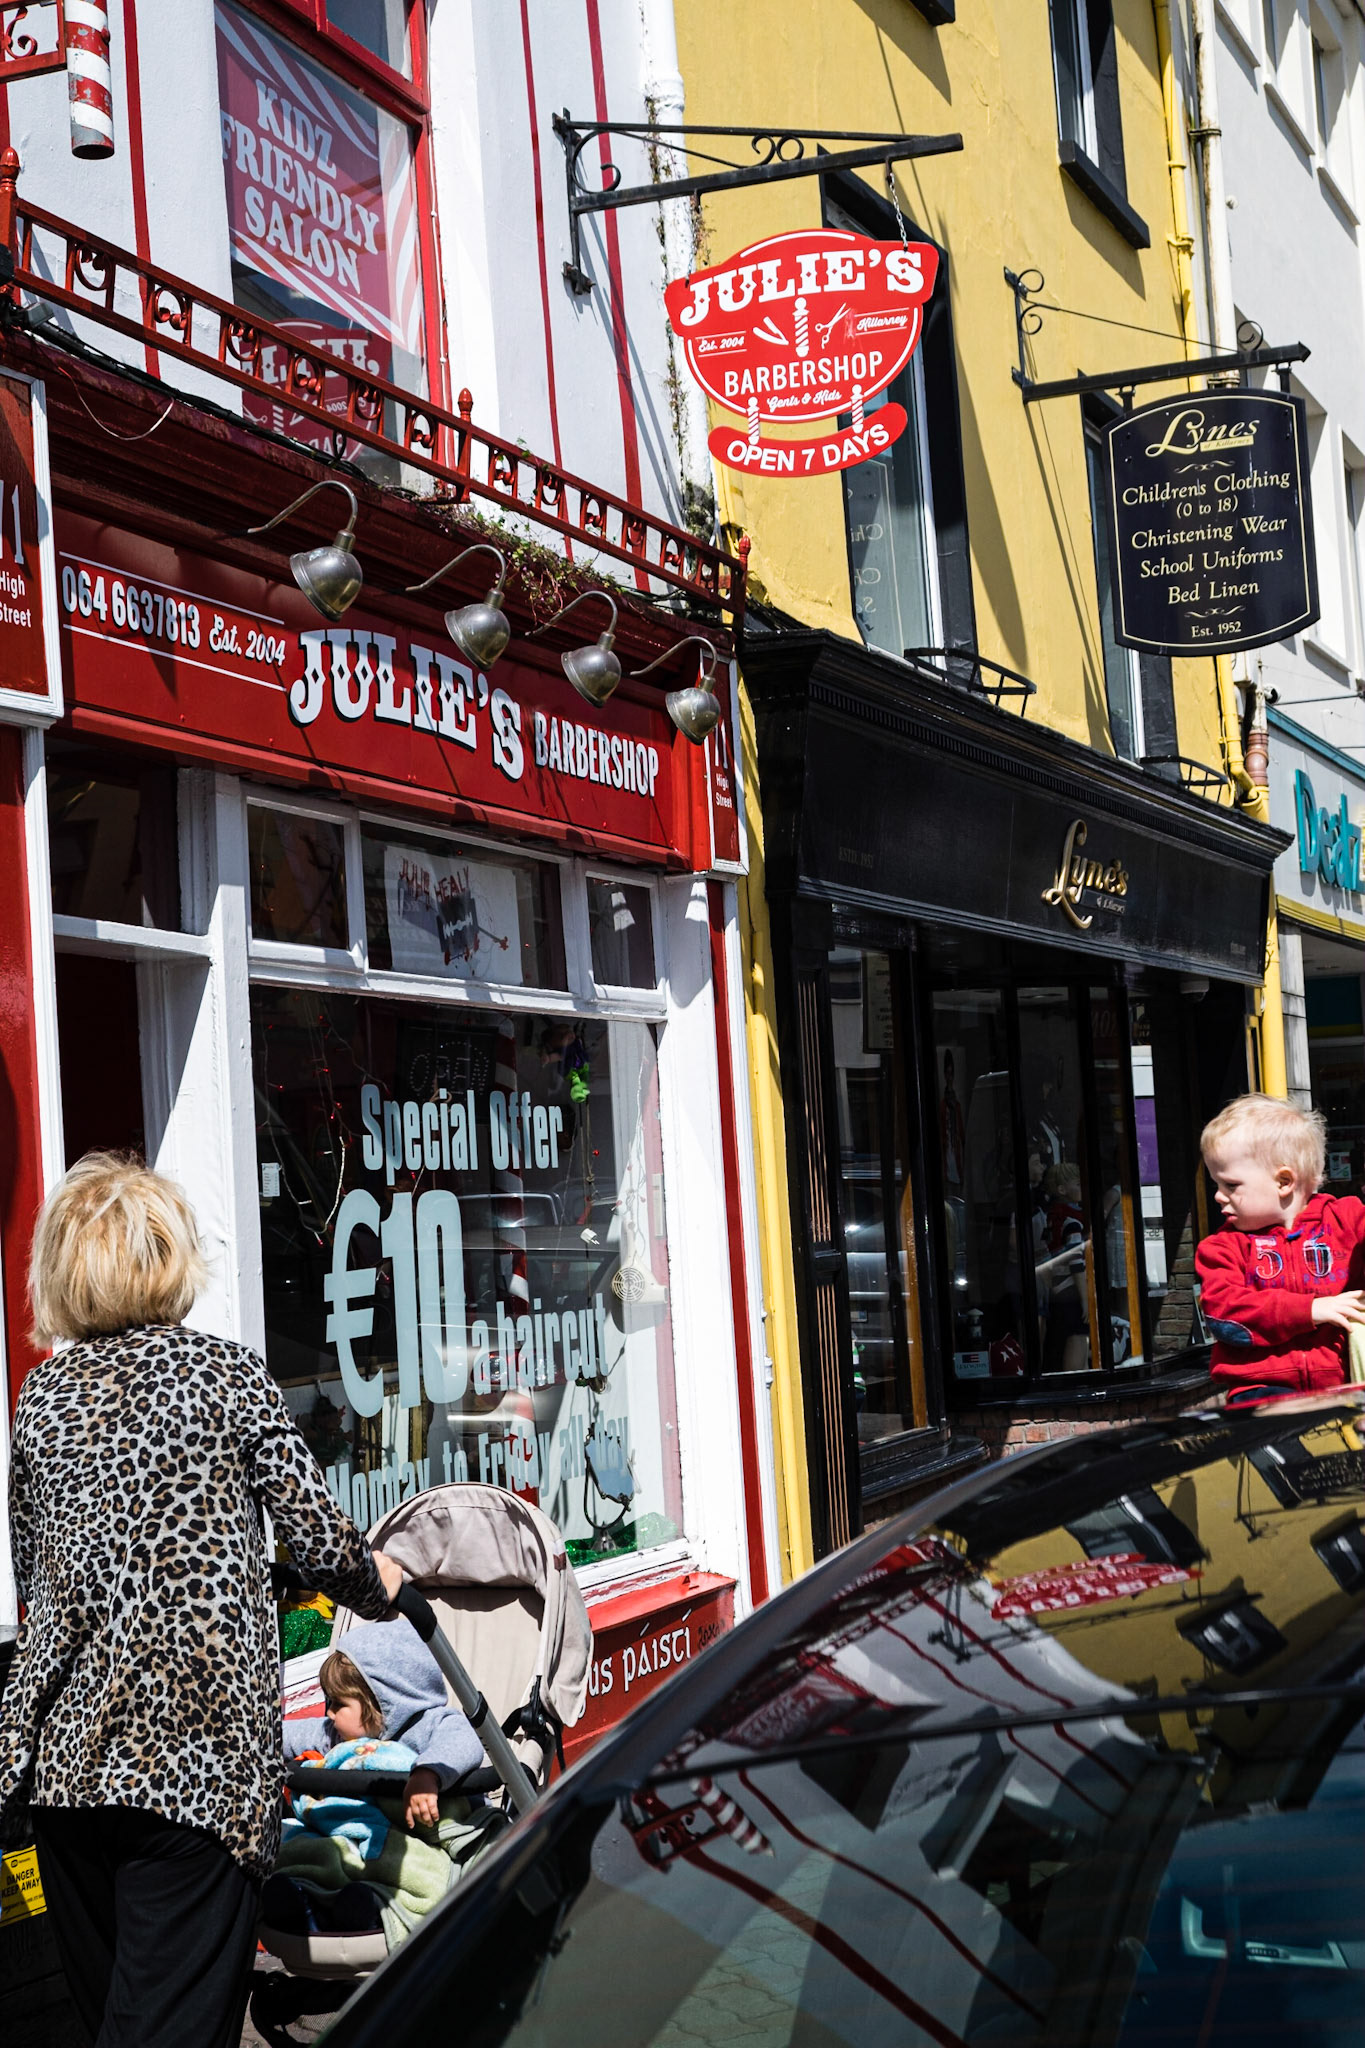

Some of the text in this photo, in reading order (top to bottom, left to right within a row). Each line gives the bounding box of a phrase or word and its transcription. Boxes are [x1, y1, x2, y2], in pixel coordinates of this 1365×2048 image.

[256, 79, 336, 179] KIDZ
[220, 110, 379, 255] FRIENDLY
[245, 186, 360, 294] SALON
[680, 249, 924, 326] JULIE'S
[698, 337, 745, 353] Est. 2004
[857, 314, 908, 331] Killarney
[724, 351, 883, 397] BARBERSHOP
[767, 390, 842, 412] Gents & Kids
[727, 423, 890, 471] OPEN 7 DAYS
[1145, 409, 1260, 457] Lynes
[1214, 471, 1291, 494] Clothing
[1177, 495, 1238, 519] (0 to 18)
[1131, 515, 1288, 549] Christening Wear
[1140, 547, 1284, 578] School Uniforms
[1168, 581, 1260, 605] Bed Linen
[62, 566, 286, 667] 064 6637813 Est. 2004
[1191, 621, 1242, 638] Est. 1952
[290, 628, 660, 797] JULIE'S BARBERSHOP
[361, 1083, 563, 1186] Special Offer
[324, 1188, 609, 1418] €10 a haircut
[443, 1440, 468, 1482] to
[478, 1426, 550, 1497] Friday
[559, 1414, 586, 1481] all
[594, 1410, 628, 1471] day
[6, 1868, 35, 1886] DANGER
[21, 1877, 40, 1891] AWAY
